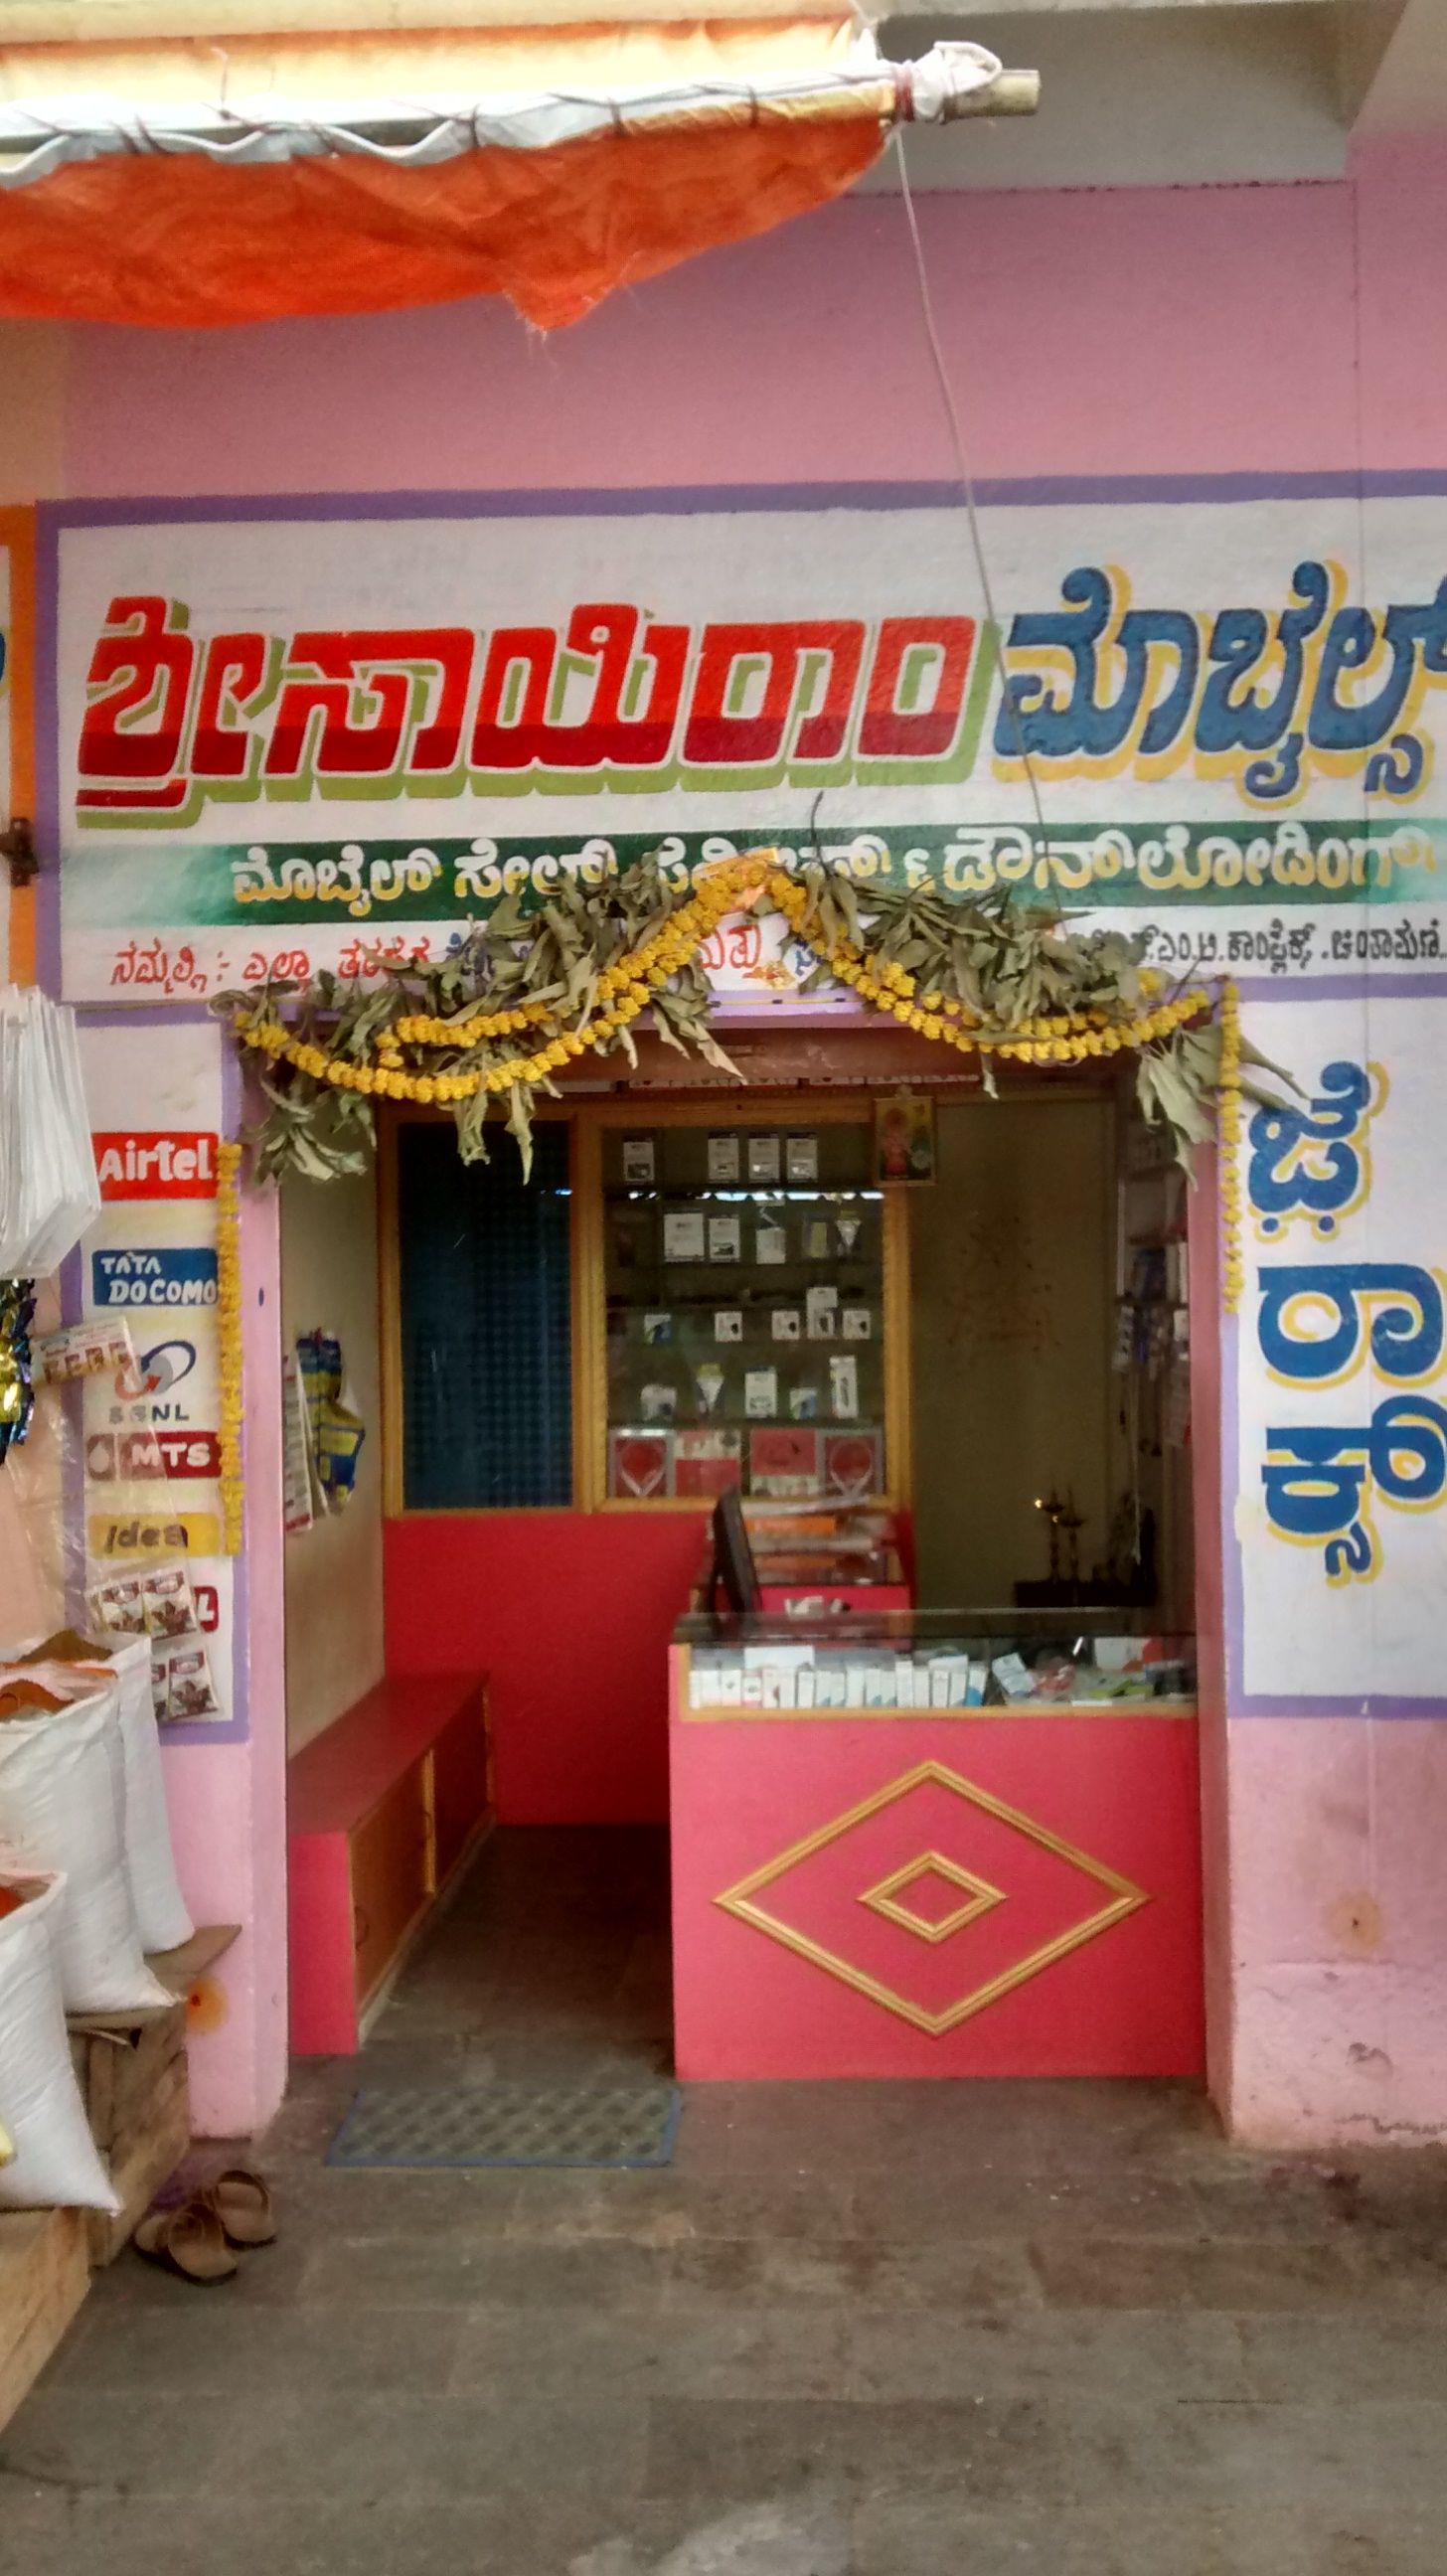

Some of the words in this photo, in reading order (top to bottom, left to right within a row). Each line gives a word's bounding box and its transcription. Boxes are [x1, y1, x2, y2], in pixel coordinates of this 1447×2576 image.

[231, 844, 442, 917] ಮೊಬೈಲ್
[100, 1139, 213, 1182] Airtel
[100, 1254, 162, 1275] TATA
[108, 1279, 218, 1305] DOCOMO
[131, 1441, 212, 1468] MTS
